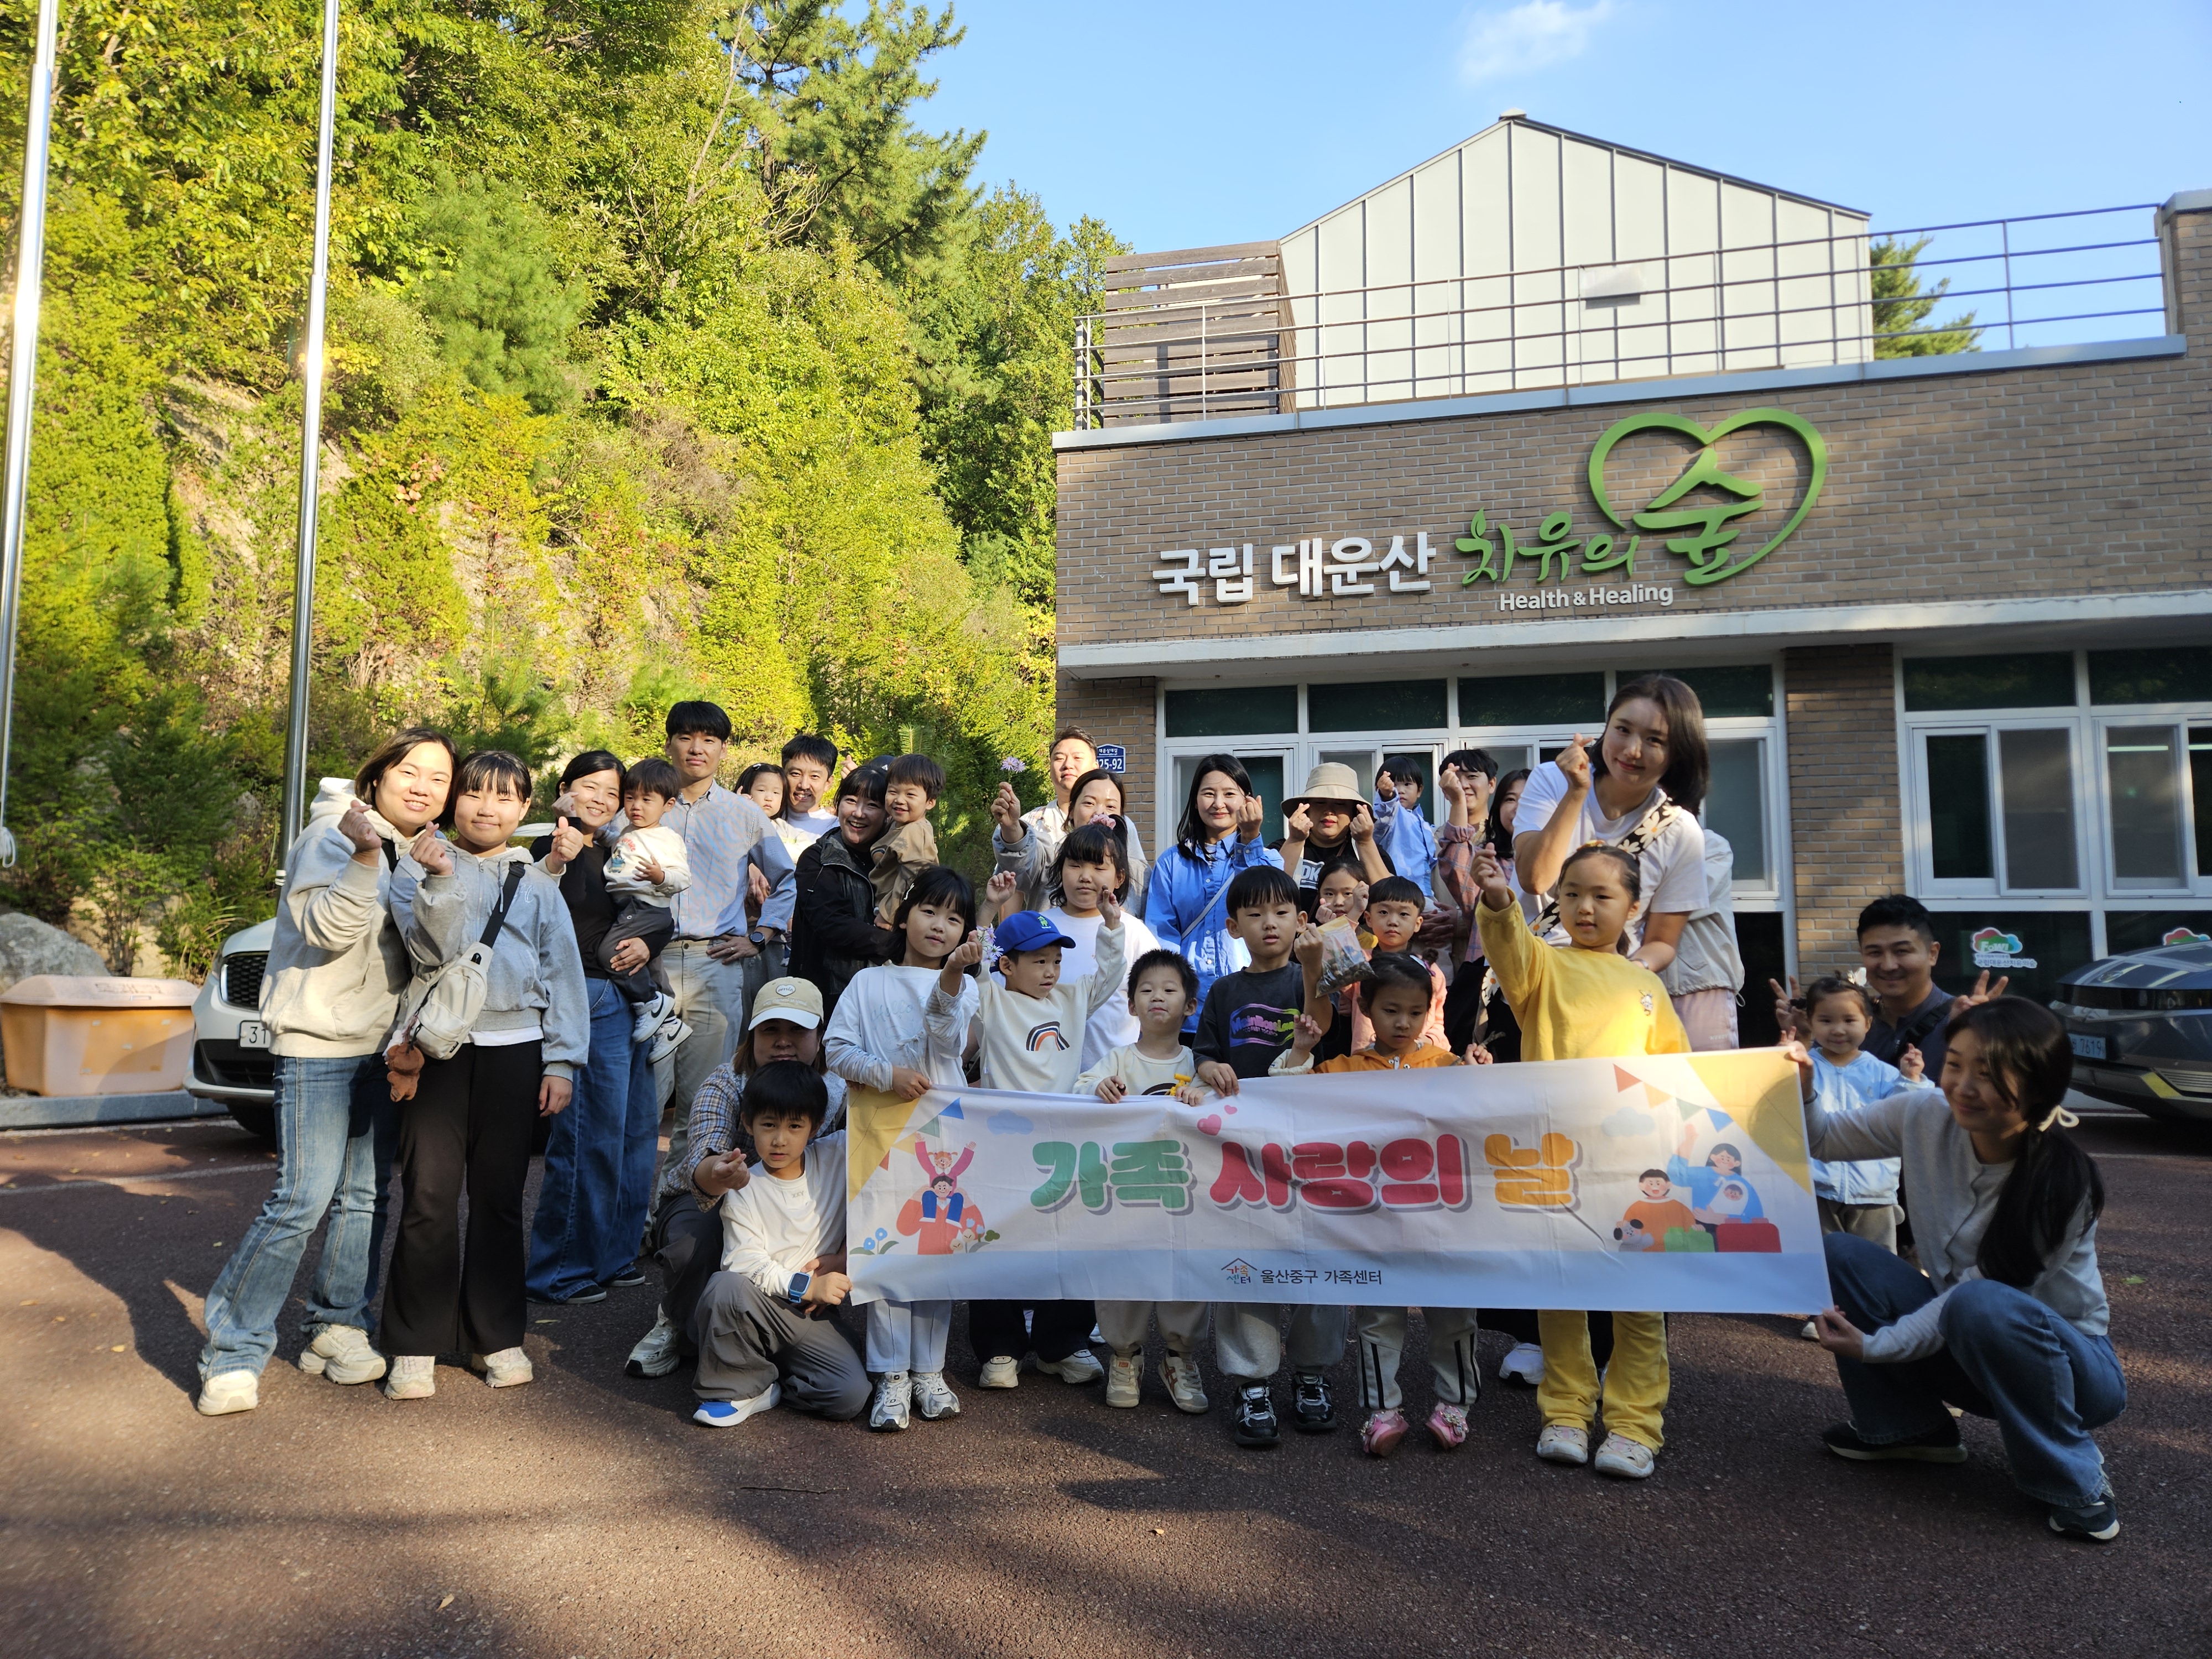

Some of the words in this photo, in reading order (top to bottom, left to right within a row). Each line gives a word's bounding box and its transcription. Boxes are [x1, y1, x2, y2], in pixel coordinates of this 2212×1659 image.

[1152, 542, 1254, 606] 국립
[1272, 531, 1437, 598] 대운산
[1455, 507, 1640, 587] 치유의
[1500, 588, 1569, 611] Health
[1573, 591, 1587, 606] &
[1589, 583, 1673, 607] Healing
[1031, 1139, 1194, 1215] 가족
[1209, 1133, 1470, 1215] 사랑의
[1484, 1132, 1584, 1213] 날
[1260, 1270, 1318, 1284] 울산중구
[1324, 1270, 1382, 1285] 가족센터
